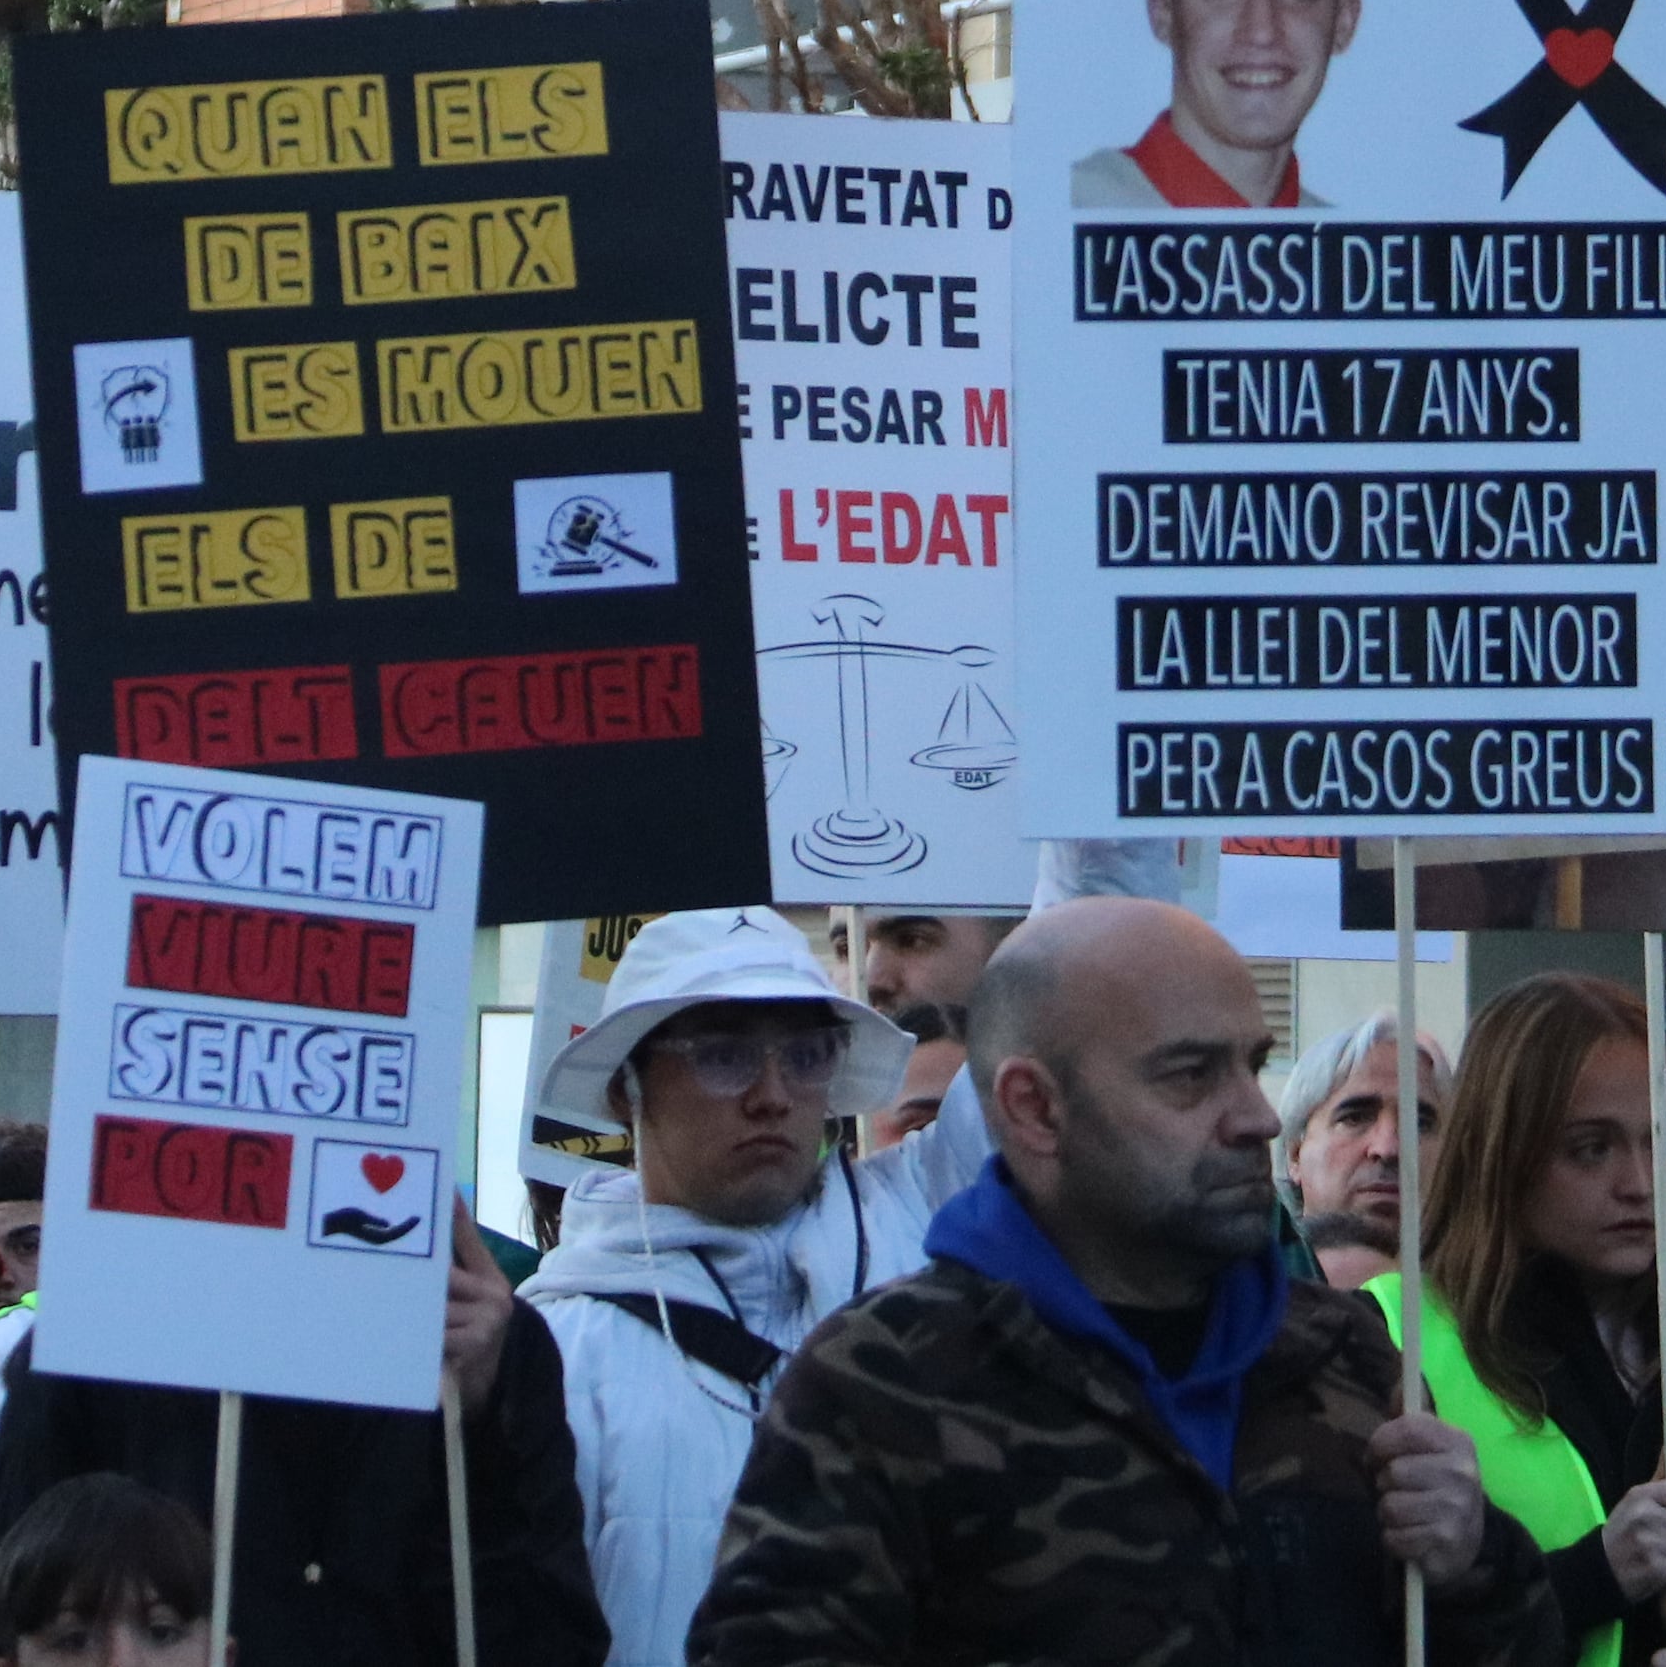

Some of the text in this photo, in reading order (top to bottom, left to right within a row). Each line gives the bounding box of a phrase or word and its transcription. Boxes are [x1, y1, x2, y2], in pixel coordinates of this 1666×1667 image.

[119, 68, 588, 175] QUAN ELS
[724, 161, 968, 228] RAVETAT
[199, 202, 564, 303] DE BAIX
[1083, 223, 1323, 315] L'ASSASSÍ
[1342, 235, 1436, 312] DEL
[1449, 235, 1566, 312] MEU
[736, 267, 980, 349] ELICTE
[244, 346, 355, 433] ES
[388, 328, 695, 426] MOUEN
[771, 384, 947, 446] PESAR
[963, 387, 1009, 448] M
[1176, 357, 1570, 437] TENIA 17 ANYS.
[137, 508, 453, 606] ELS DE
[779, 488, 1009, 566] L'EDAT
[1108, 481, 1647, 561] DEMANO REVISAR JA
[1133, 606, 1622, 686] LA LLEI DEL MENOR
[125, 650, 697, 762] DALT CAUEN
[954, 771, 993, 784] EDAT
[1128, 730, 1644, 810] PER A CASOS GREUS
[134, 791, 431, 904] VOLEM
[134, 899, 410, 1011] VIURE
[117, 1007, 403, 1122] SENSE
[97, 1121, 275, 1223] POR
